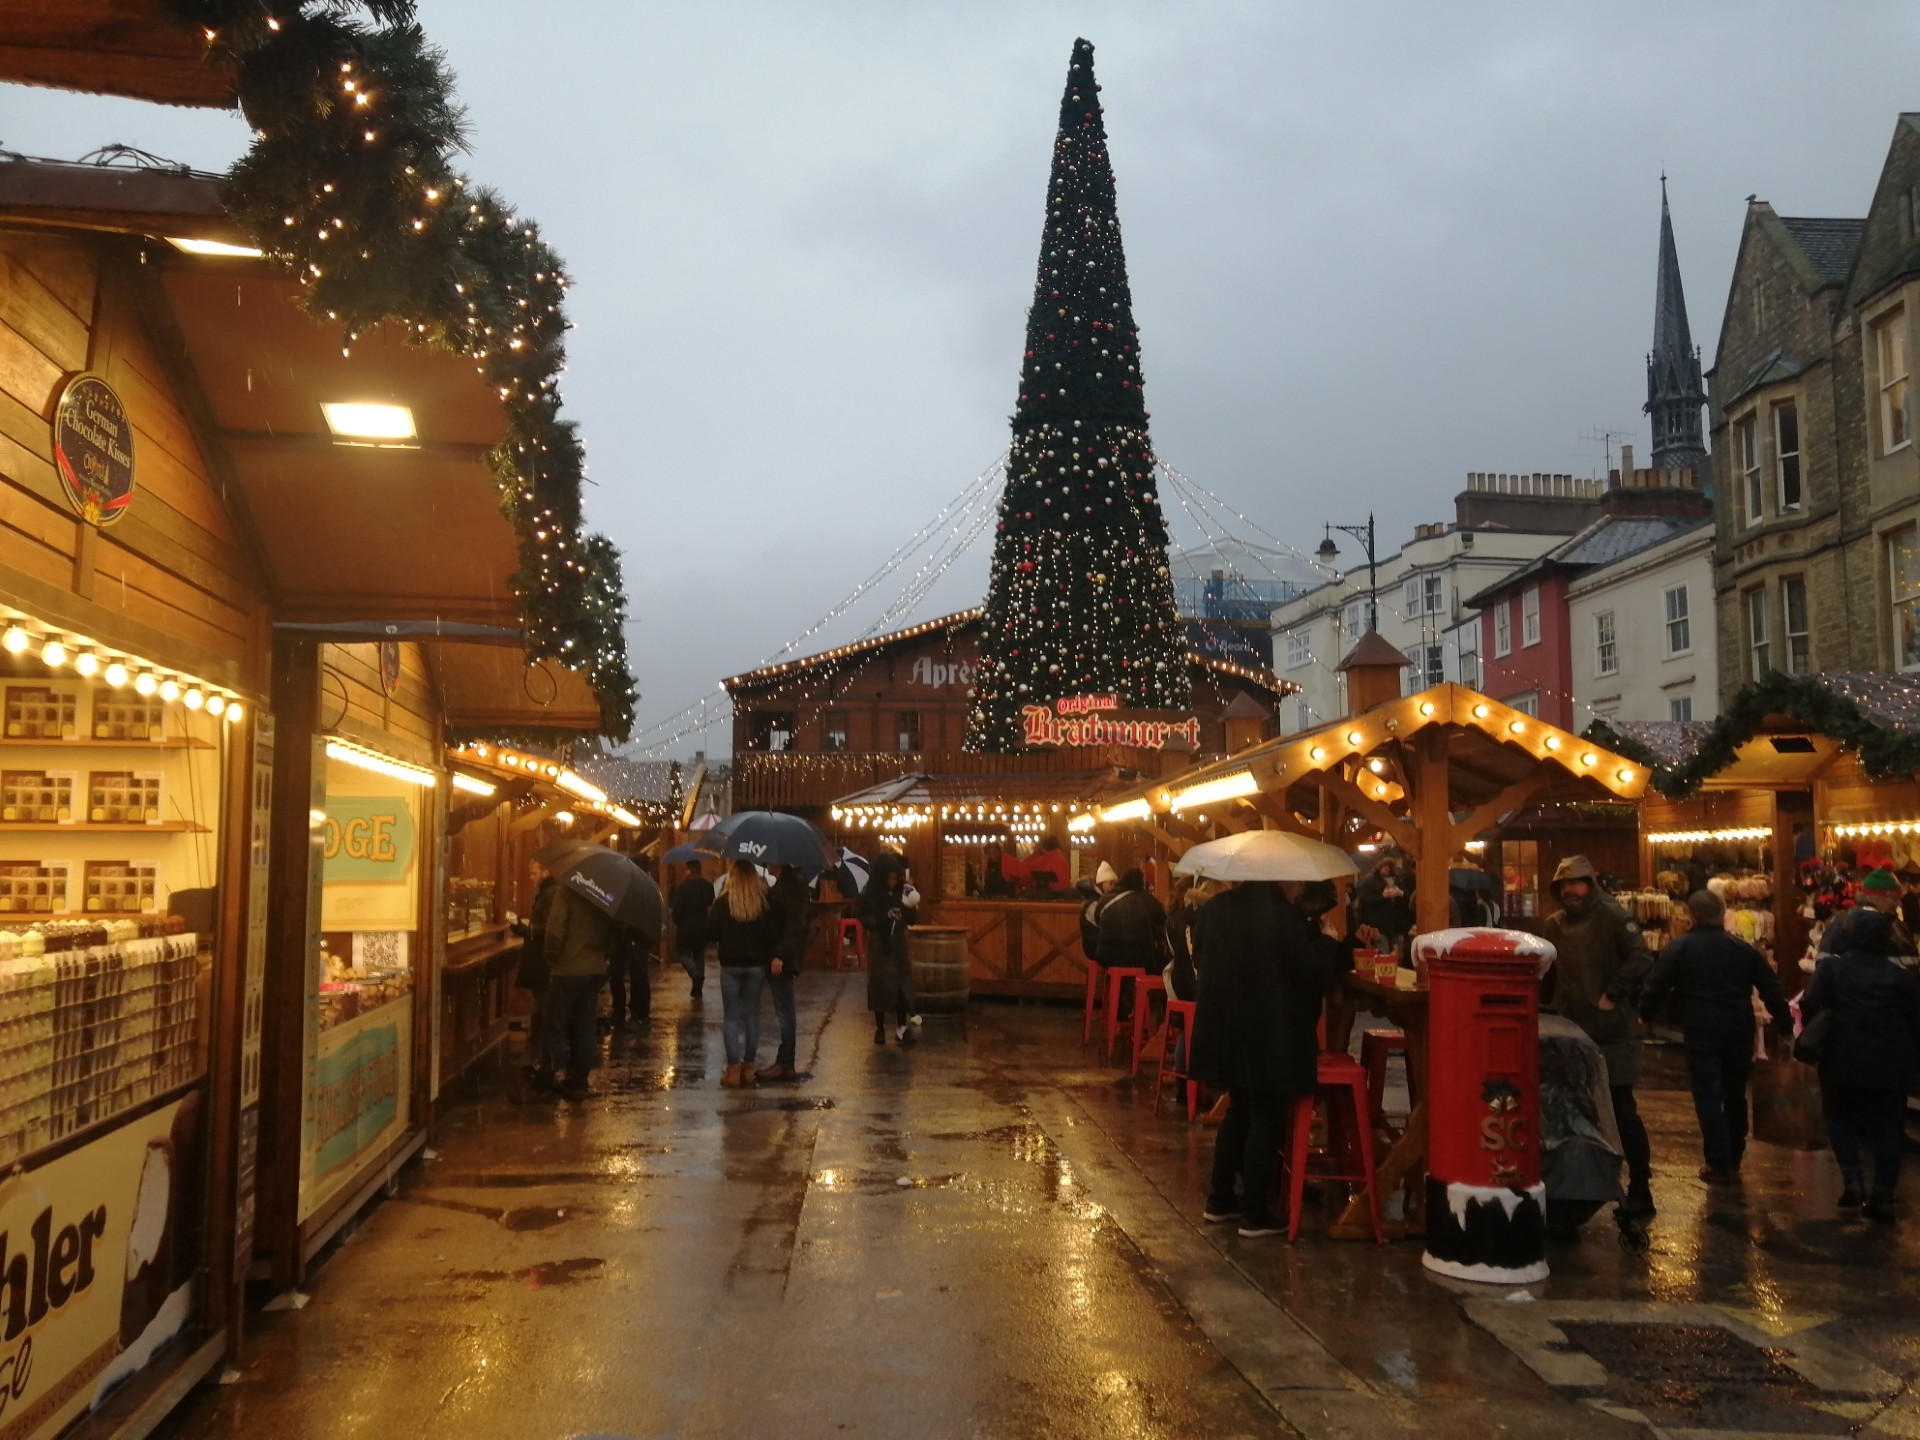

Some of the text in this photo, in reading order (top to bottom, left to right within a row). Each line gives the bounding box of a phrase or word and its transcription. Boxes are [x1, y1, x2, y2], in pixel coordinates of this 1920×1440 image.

[86, 399, 118, 438] German
[66, 407, 131, 469] Chocolate Kisses
[1057, 694, 1118, 714] Original
[738, 840, 768, 858] sky
[1480, 1117, 1528, 1151] SC
